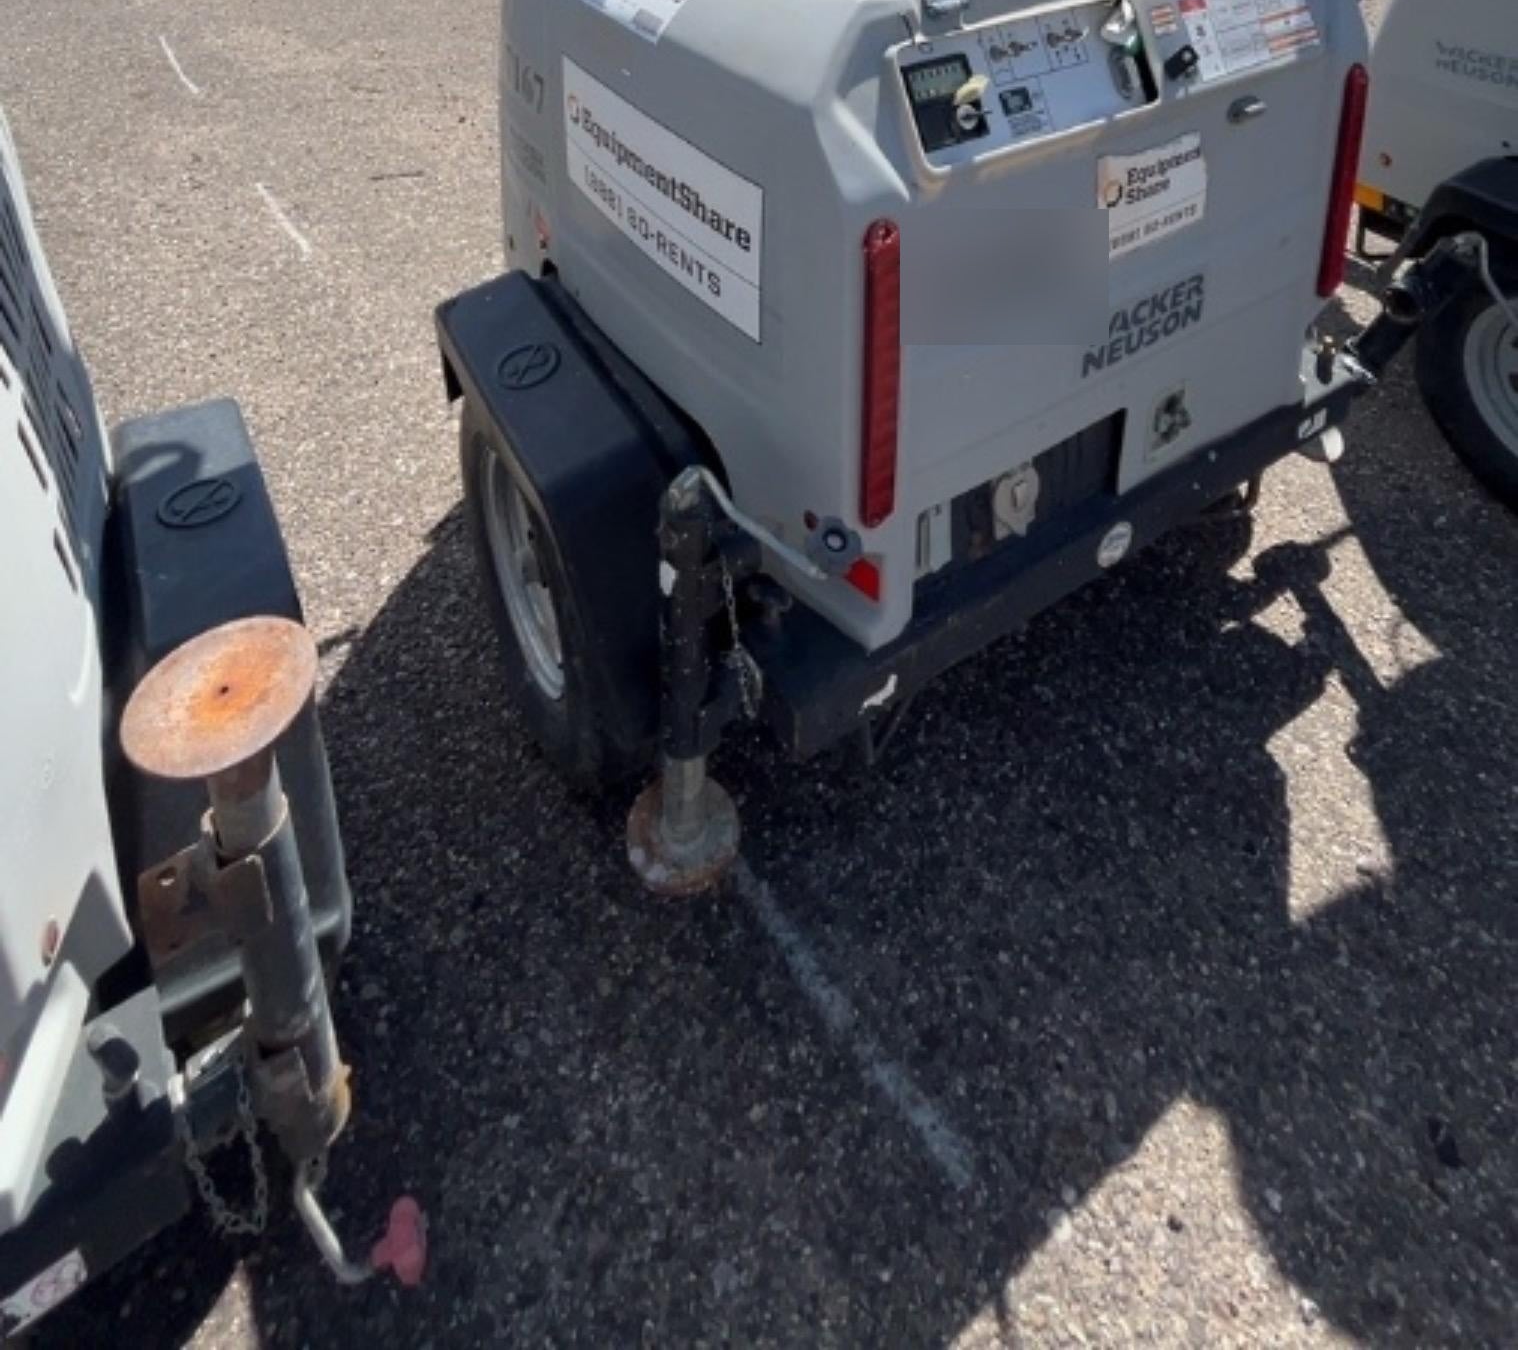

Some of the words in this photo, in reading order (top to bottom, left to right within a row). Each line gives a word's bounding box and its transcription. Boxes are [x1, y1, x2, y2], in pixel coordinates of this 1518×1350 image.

[581, 107, 751, 252] EquipmentShare
[1082, 298, 1204, 378] NEUSON
[1109, 273, 1204, 340] ACKER
